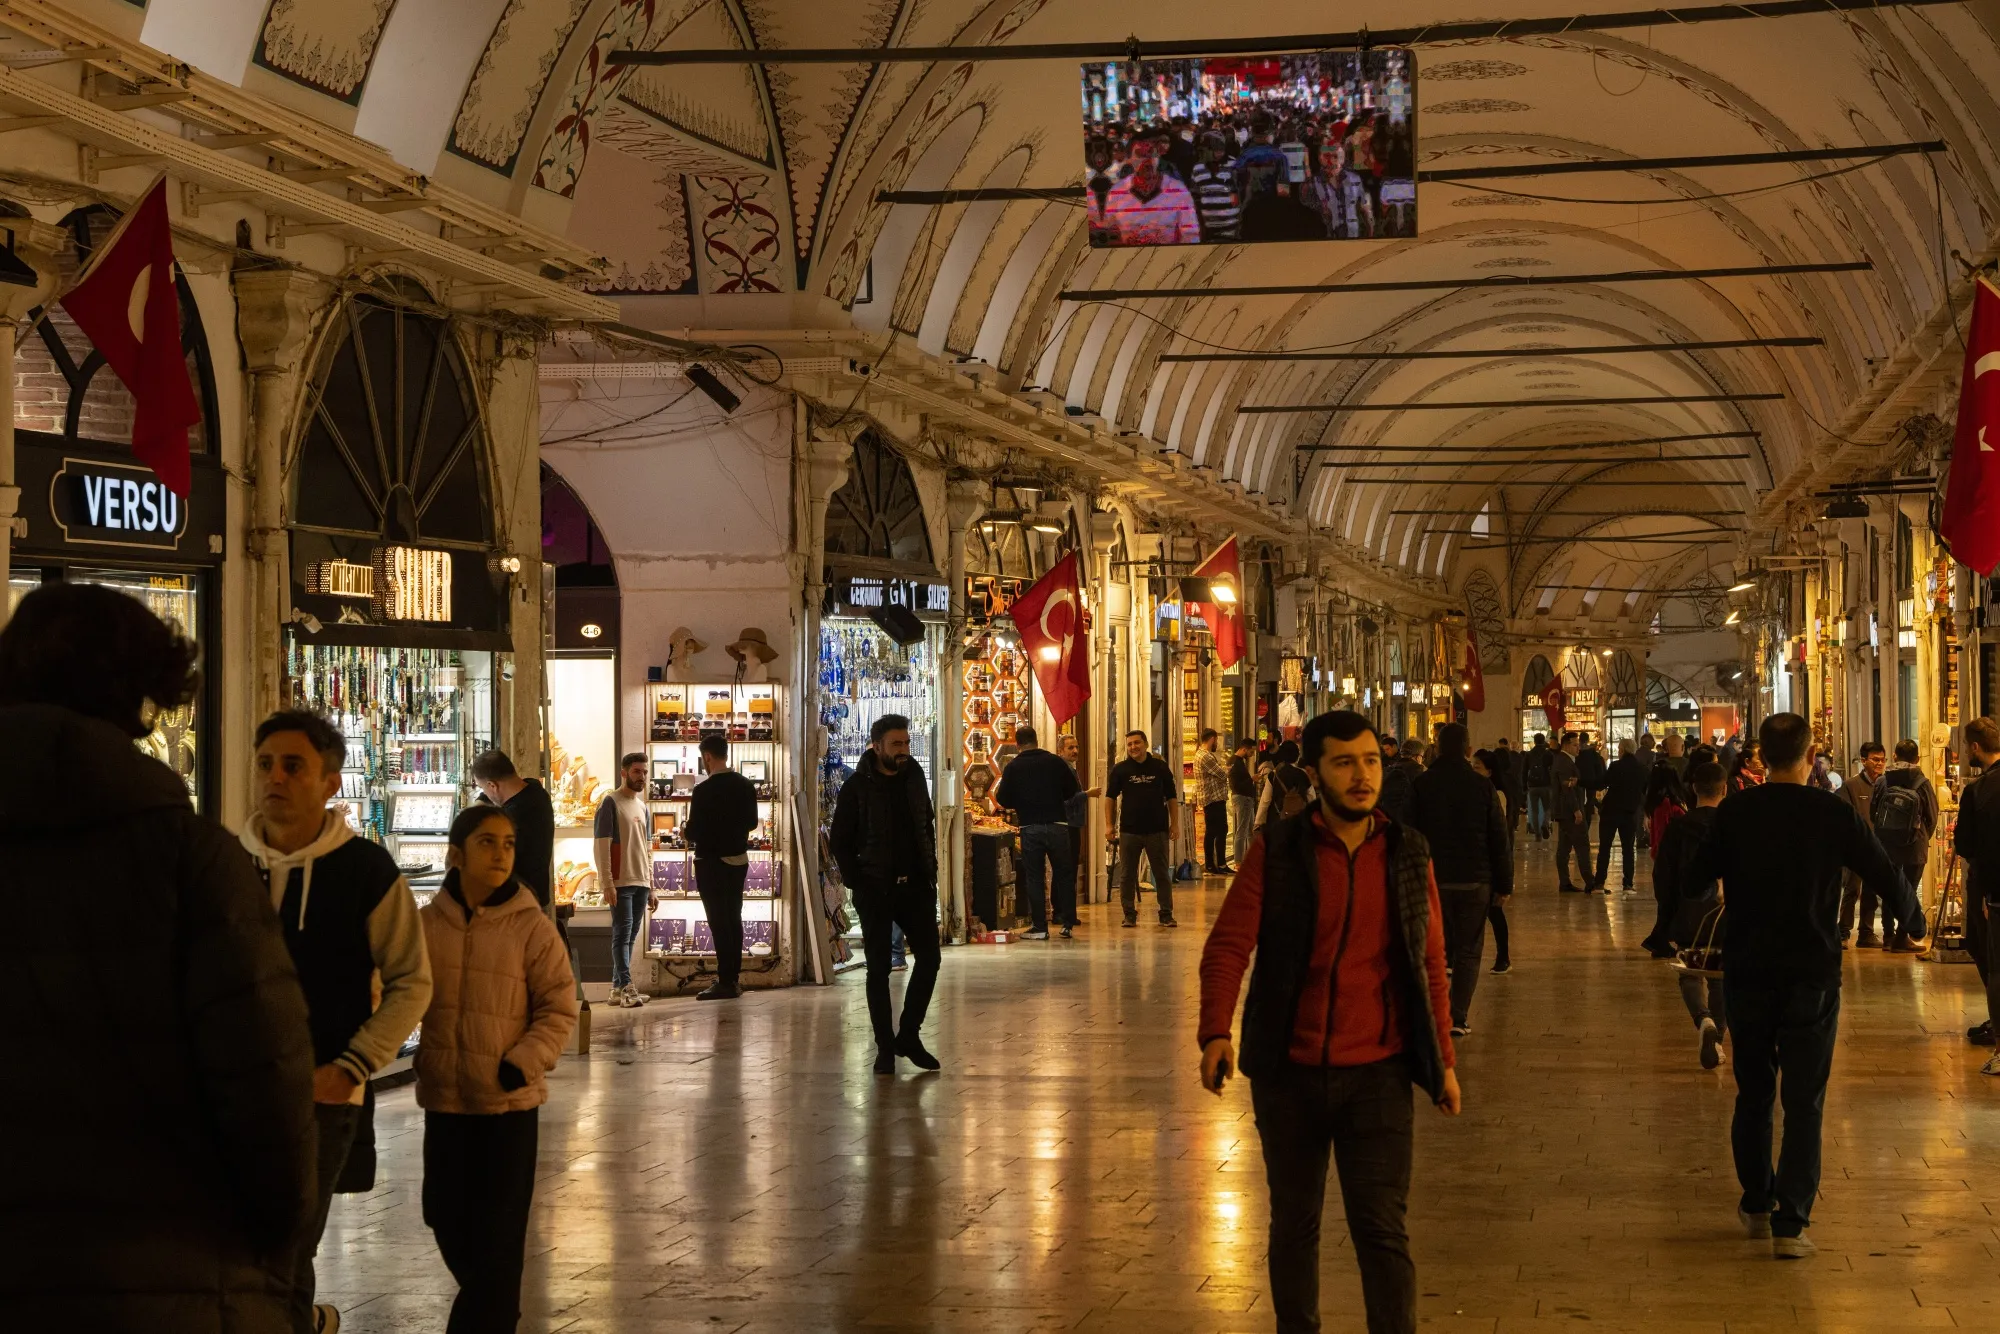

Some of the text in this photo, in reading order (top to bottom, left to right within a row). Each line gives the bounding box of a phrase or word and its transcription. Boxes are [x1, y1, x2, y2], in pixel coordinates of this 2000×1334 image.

[84, 474, 178, 533] VERSU
[395, 546, 451, 622] SILVER
[927, 584, 949, 612] SILVER
[583, 626, 599, 636] 4-6
